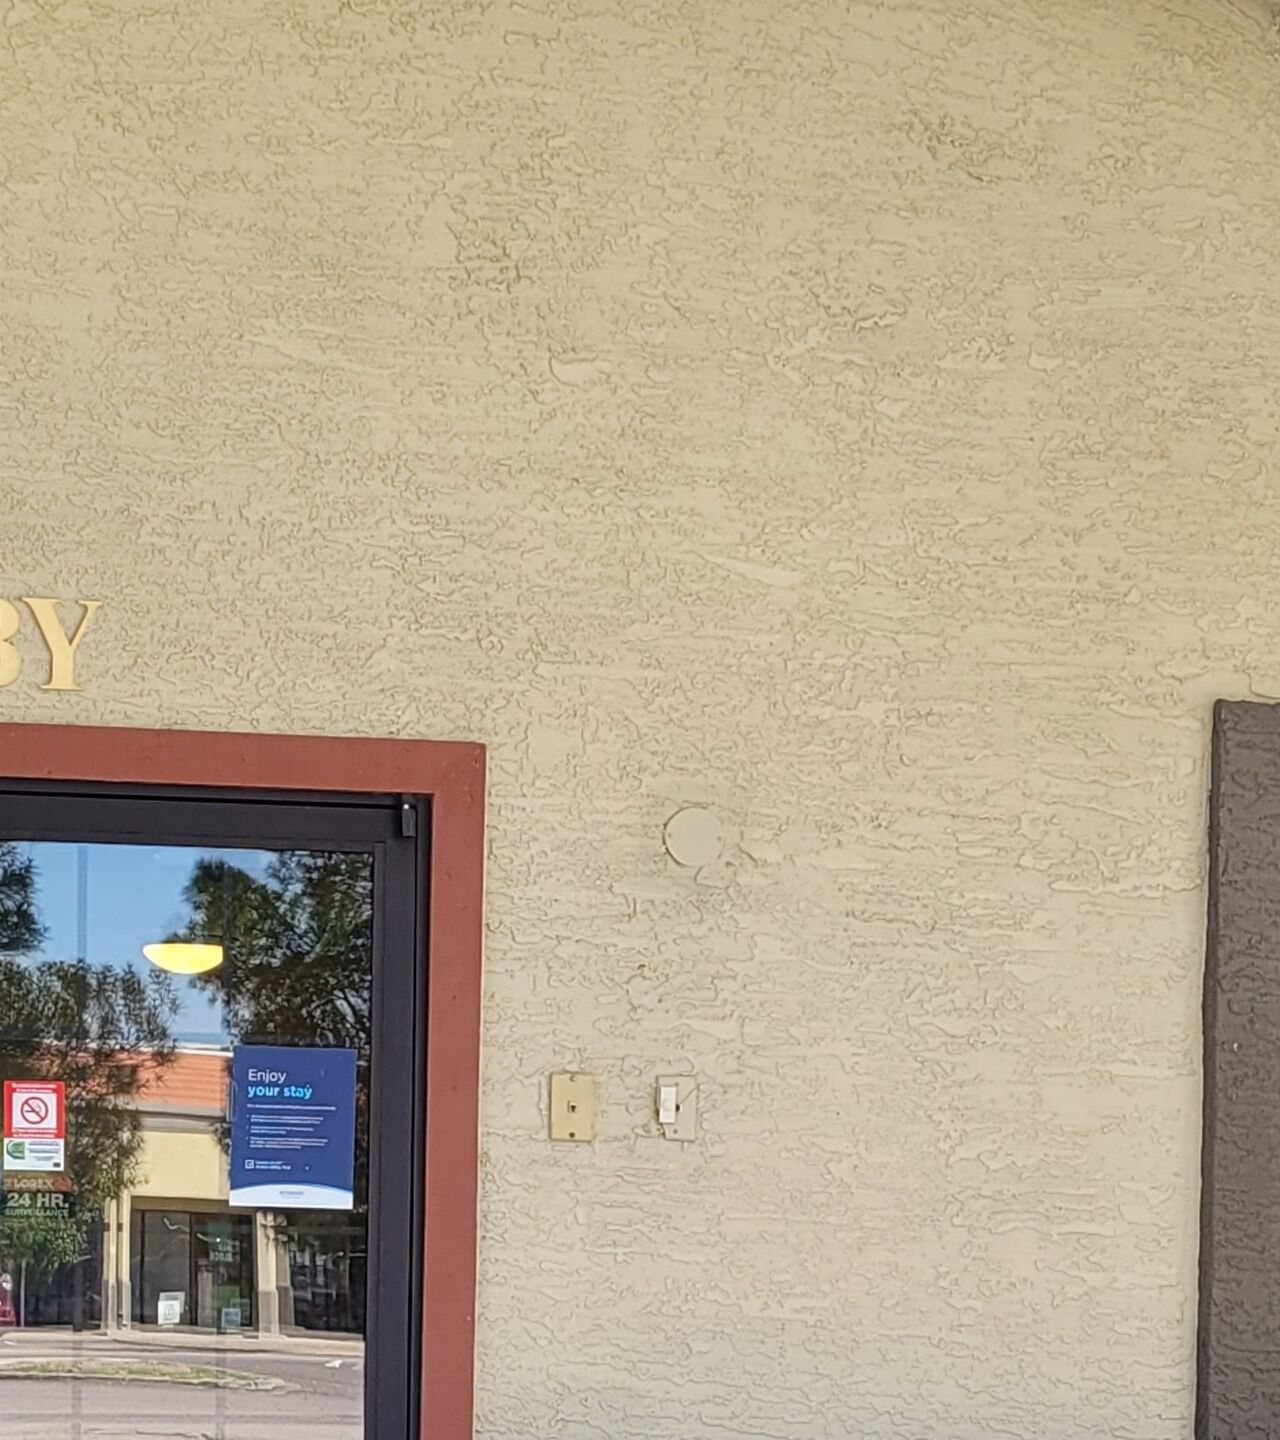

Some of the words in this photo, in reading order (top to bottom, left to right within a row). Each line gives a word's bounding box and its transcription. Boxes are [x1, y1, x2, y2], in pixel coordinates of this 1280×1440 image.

[248, 1068, 287, 1084] Enjoy
[247, 1085, 280, 1099] your
[283, 1085, 313, 1099] stay
[6, 1192, 32, 1208] 24
[36, 1192, 70, 1208] HR.
